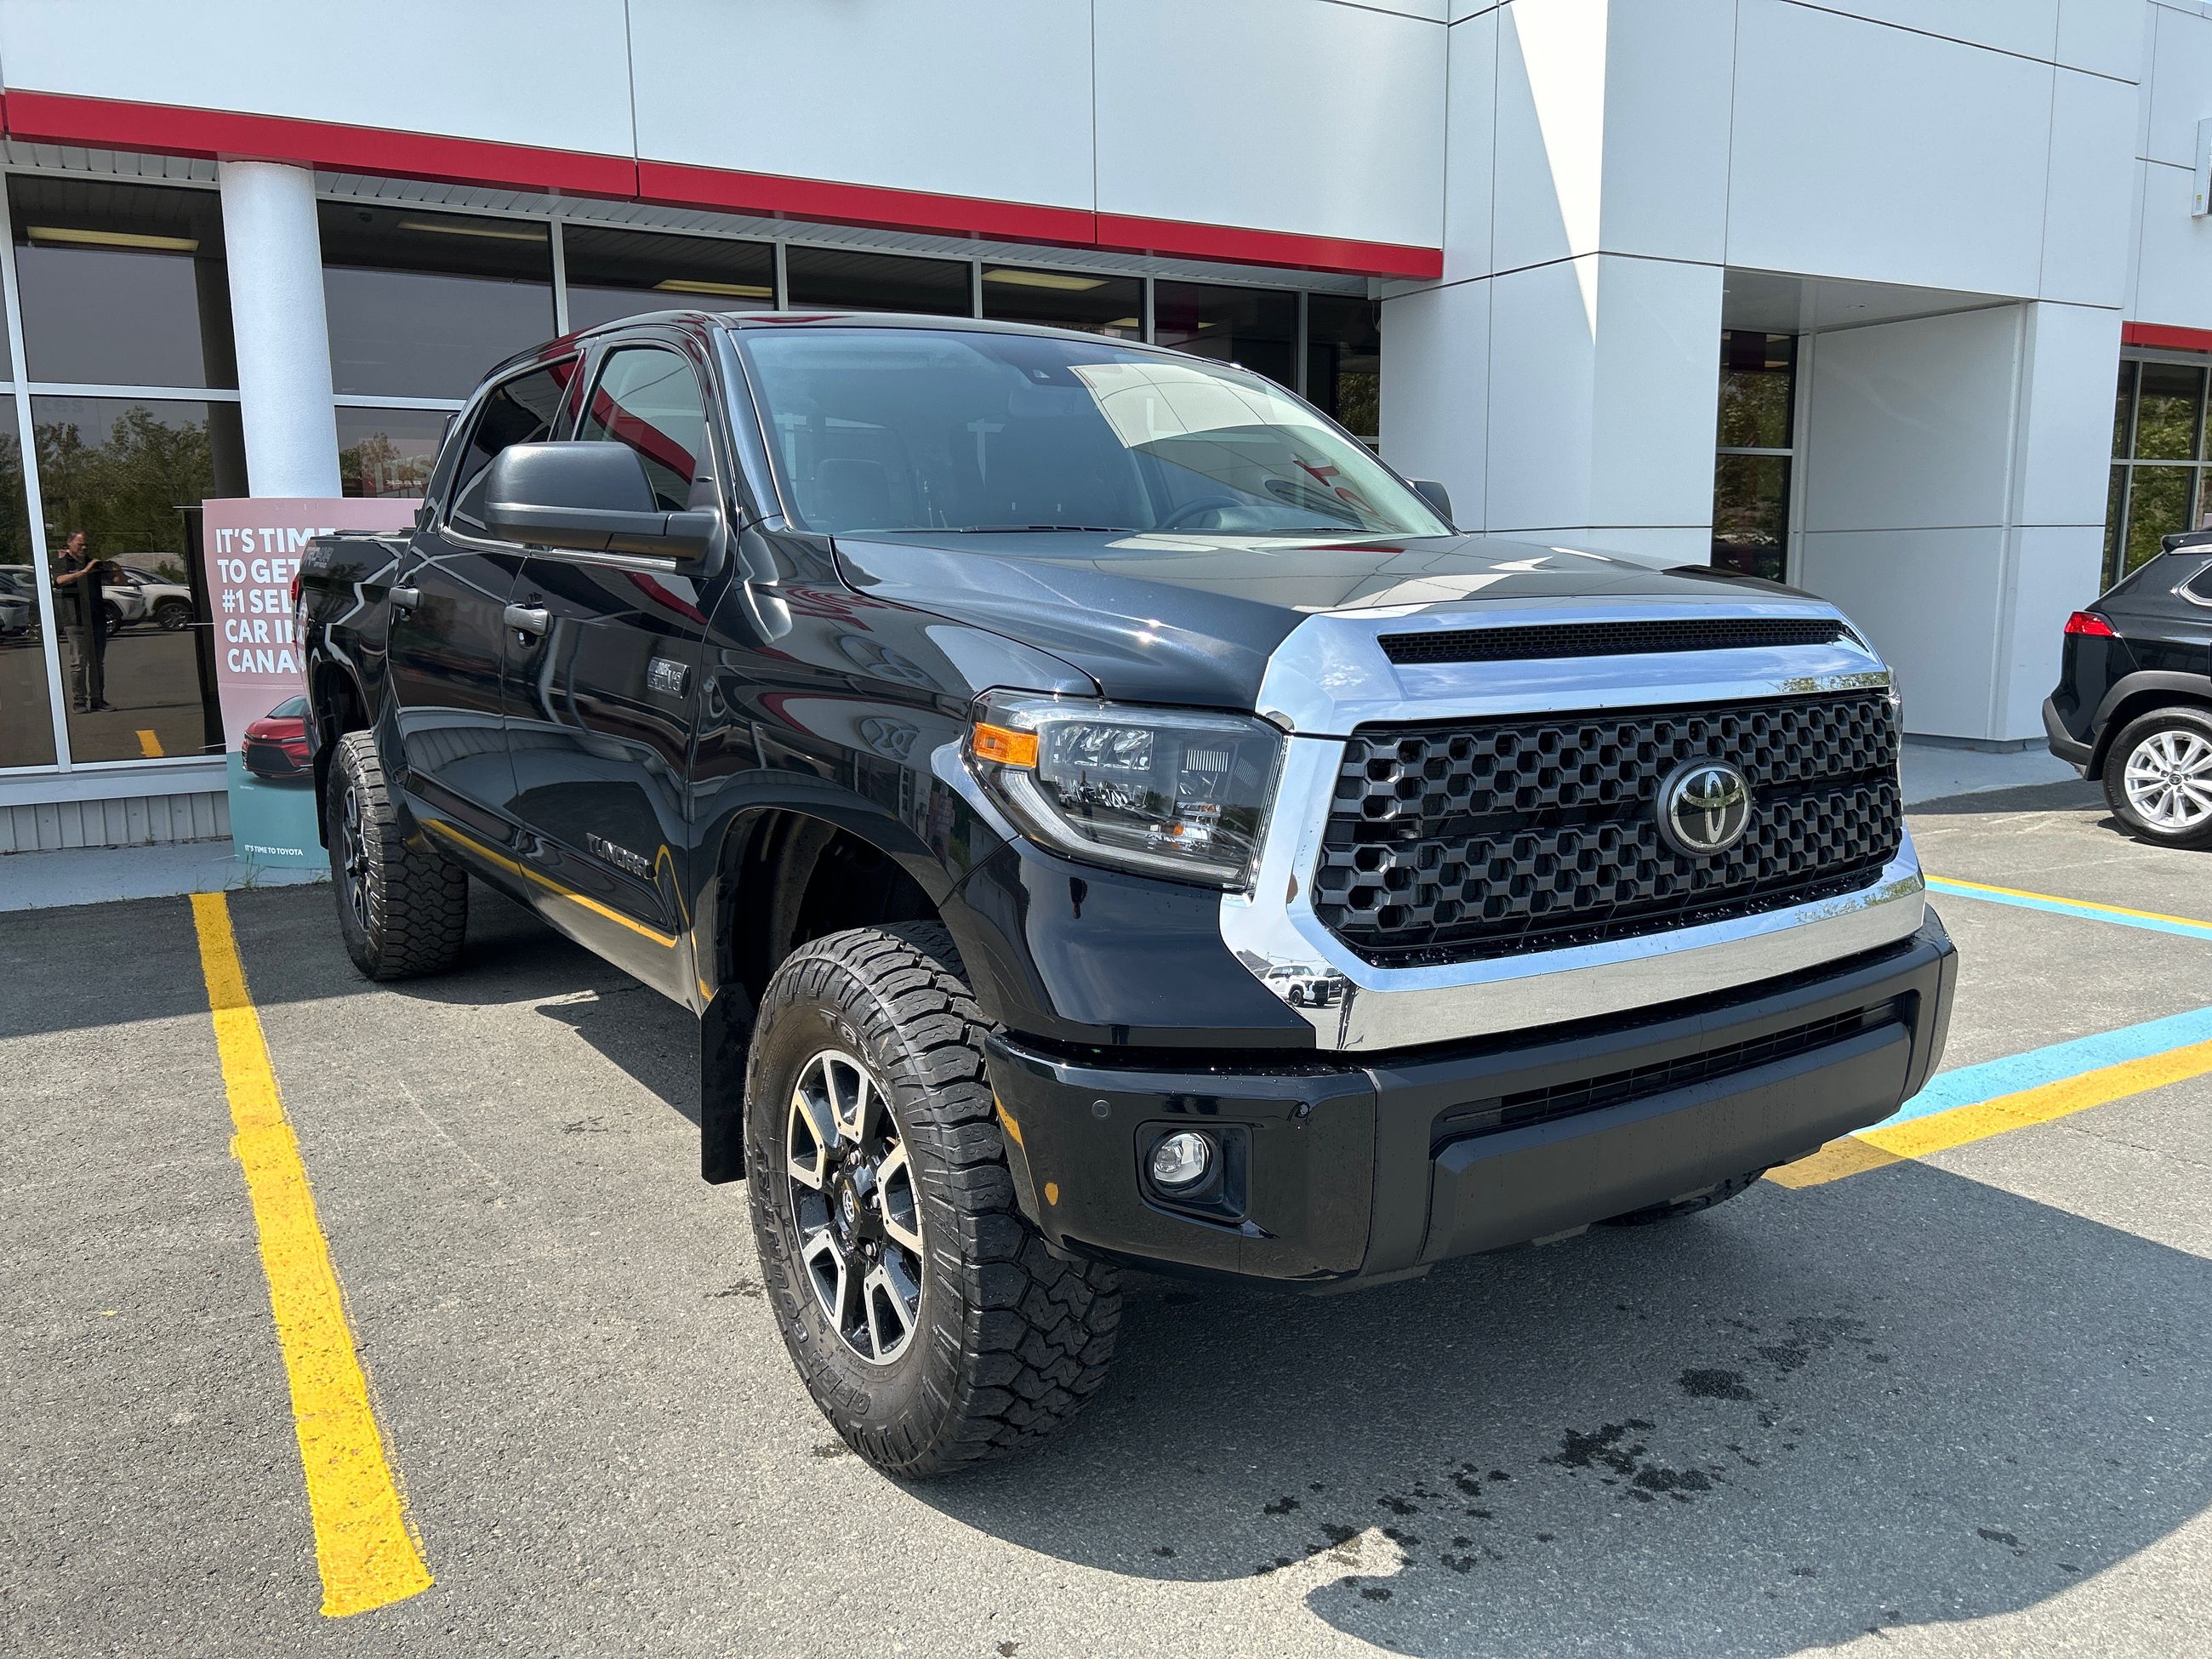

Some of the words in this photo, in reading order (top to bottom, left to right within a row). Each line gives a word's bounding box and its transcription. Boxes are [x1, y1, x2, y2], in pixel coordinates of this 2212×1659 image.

[215, 527, 255, 553] IT'S
[259, 527, 336, 552] TIM
[217, 559, 247, 584] TO
[251, 558, 301, 584] GET
[222, 589, 245, 613] #1
[249, 589, 292, 613] SEL
[225, 619, 268, 644] CAR
[227, 648, 298, 674] CANA
